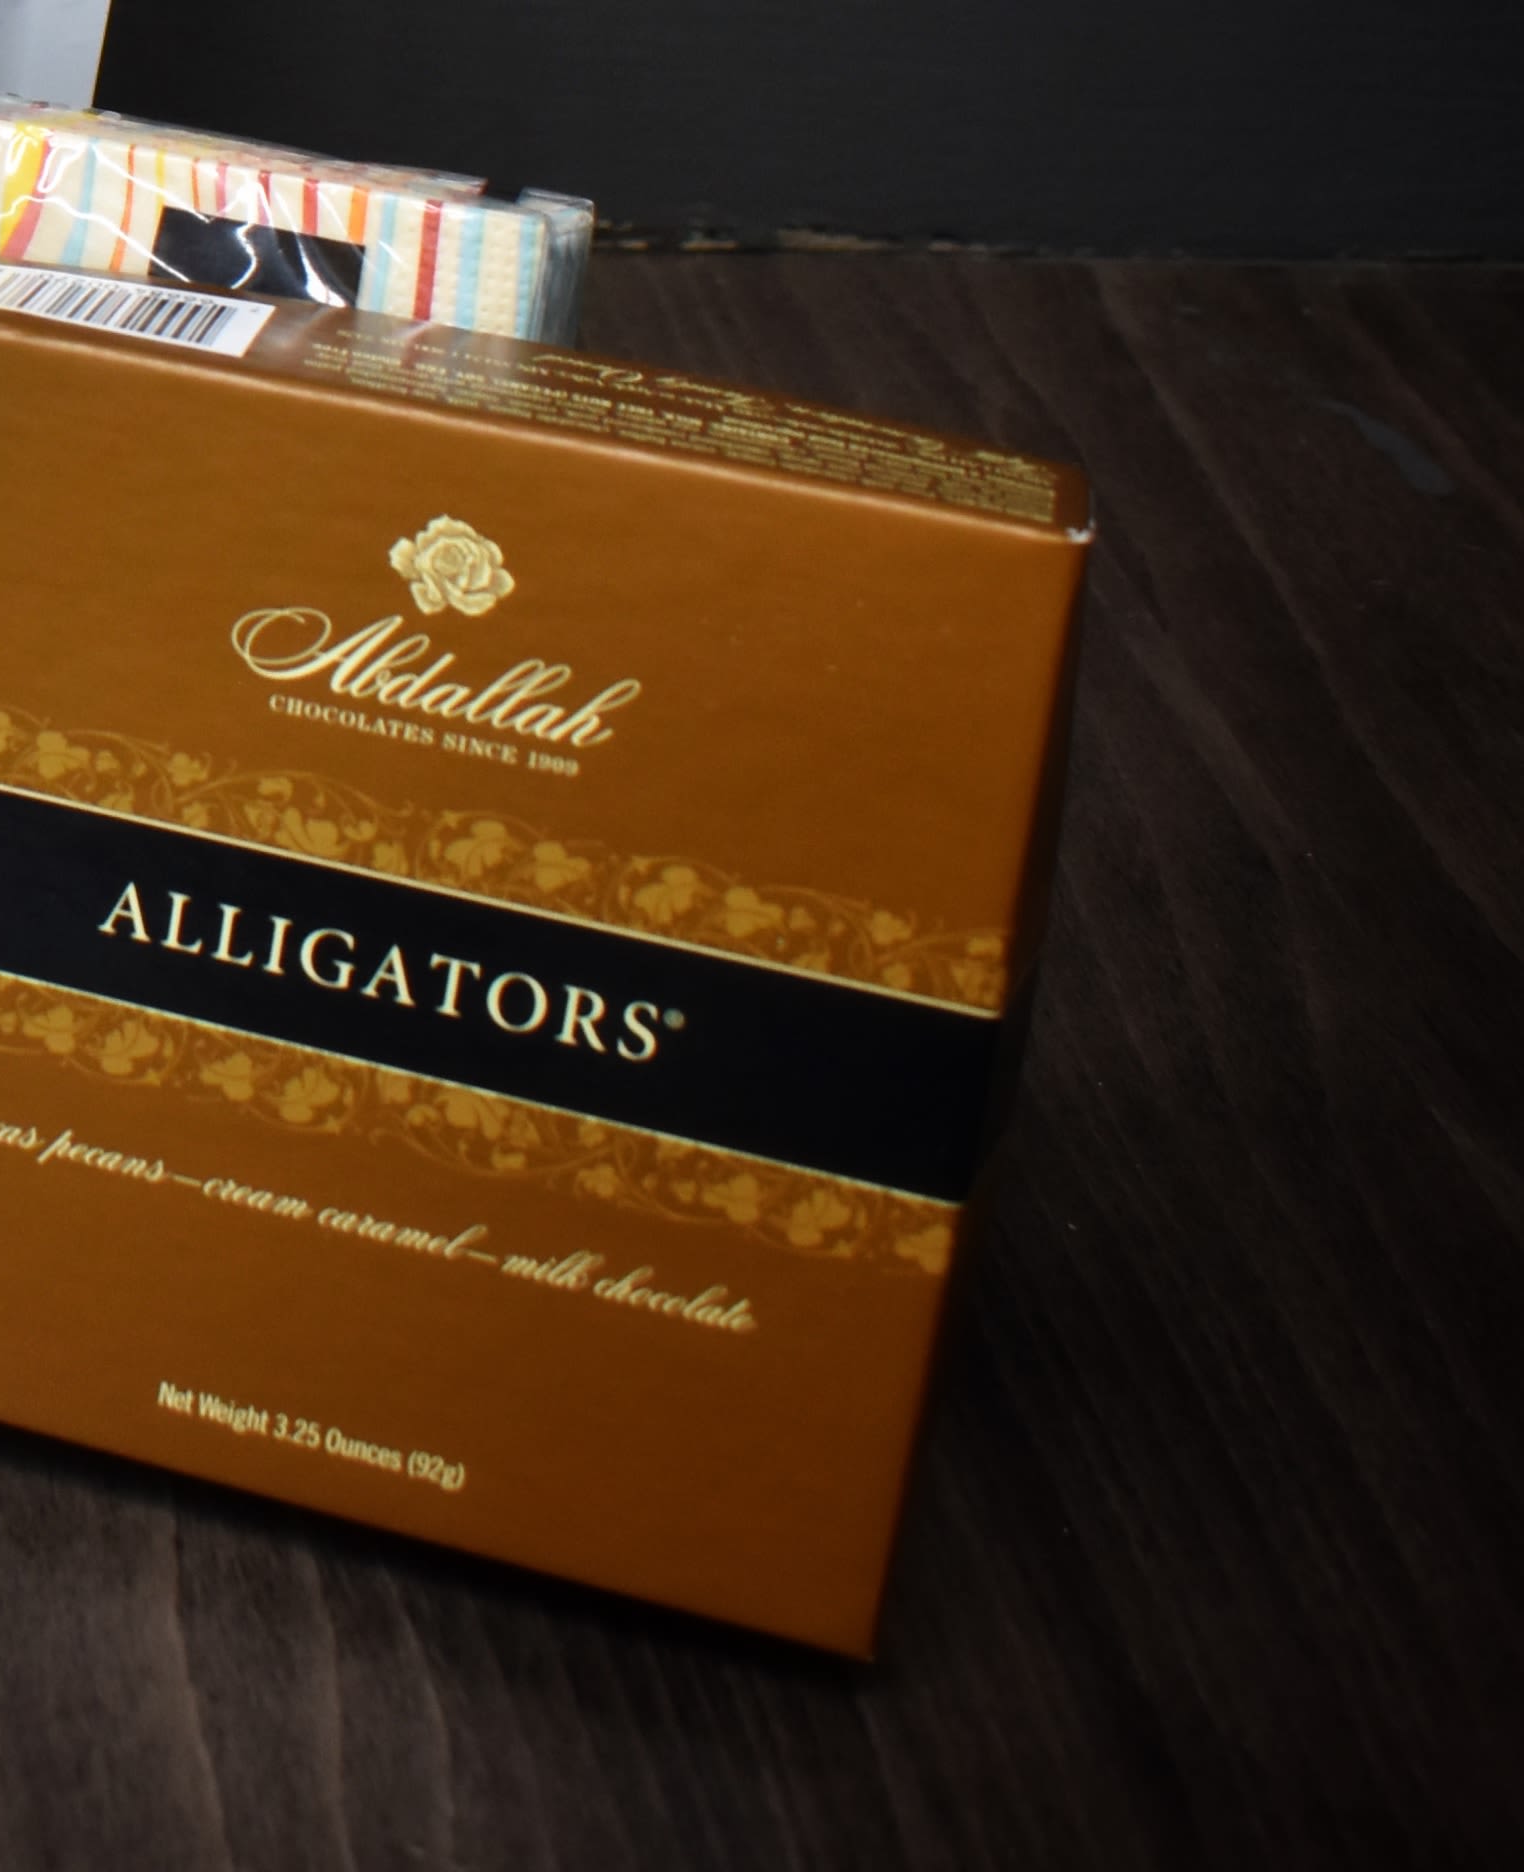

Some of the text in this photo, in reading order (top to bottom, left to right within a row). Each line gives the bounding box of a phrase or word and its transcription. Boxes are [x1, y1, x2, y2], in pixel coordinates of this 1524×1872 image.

[231, 606, 642, 748] Abdallah
[268, 692, 435, 746] CHOCOLATES
[442, 730, 518, 766] SINCE
[592, 1264, 757, 1331] chocolate
[157, 1380, 466, 1493] Net Weight 3.25 Ounces (92g)
